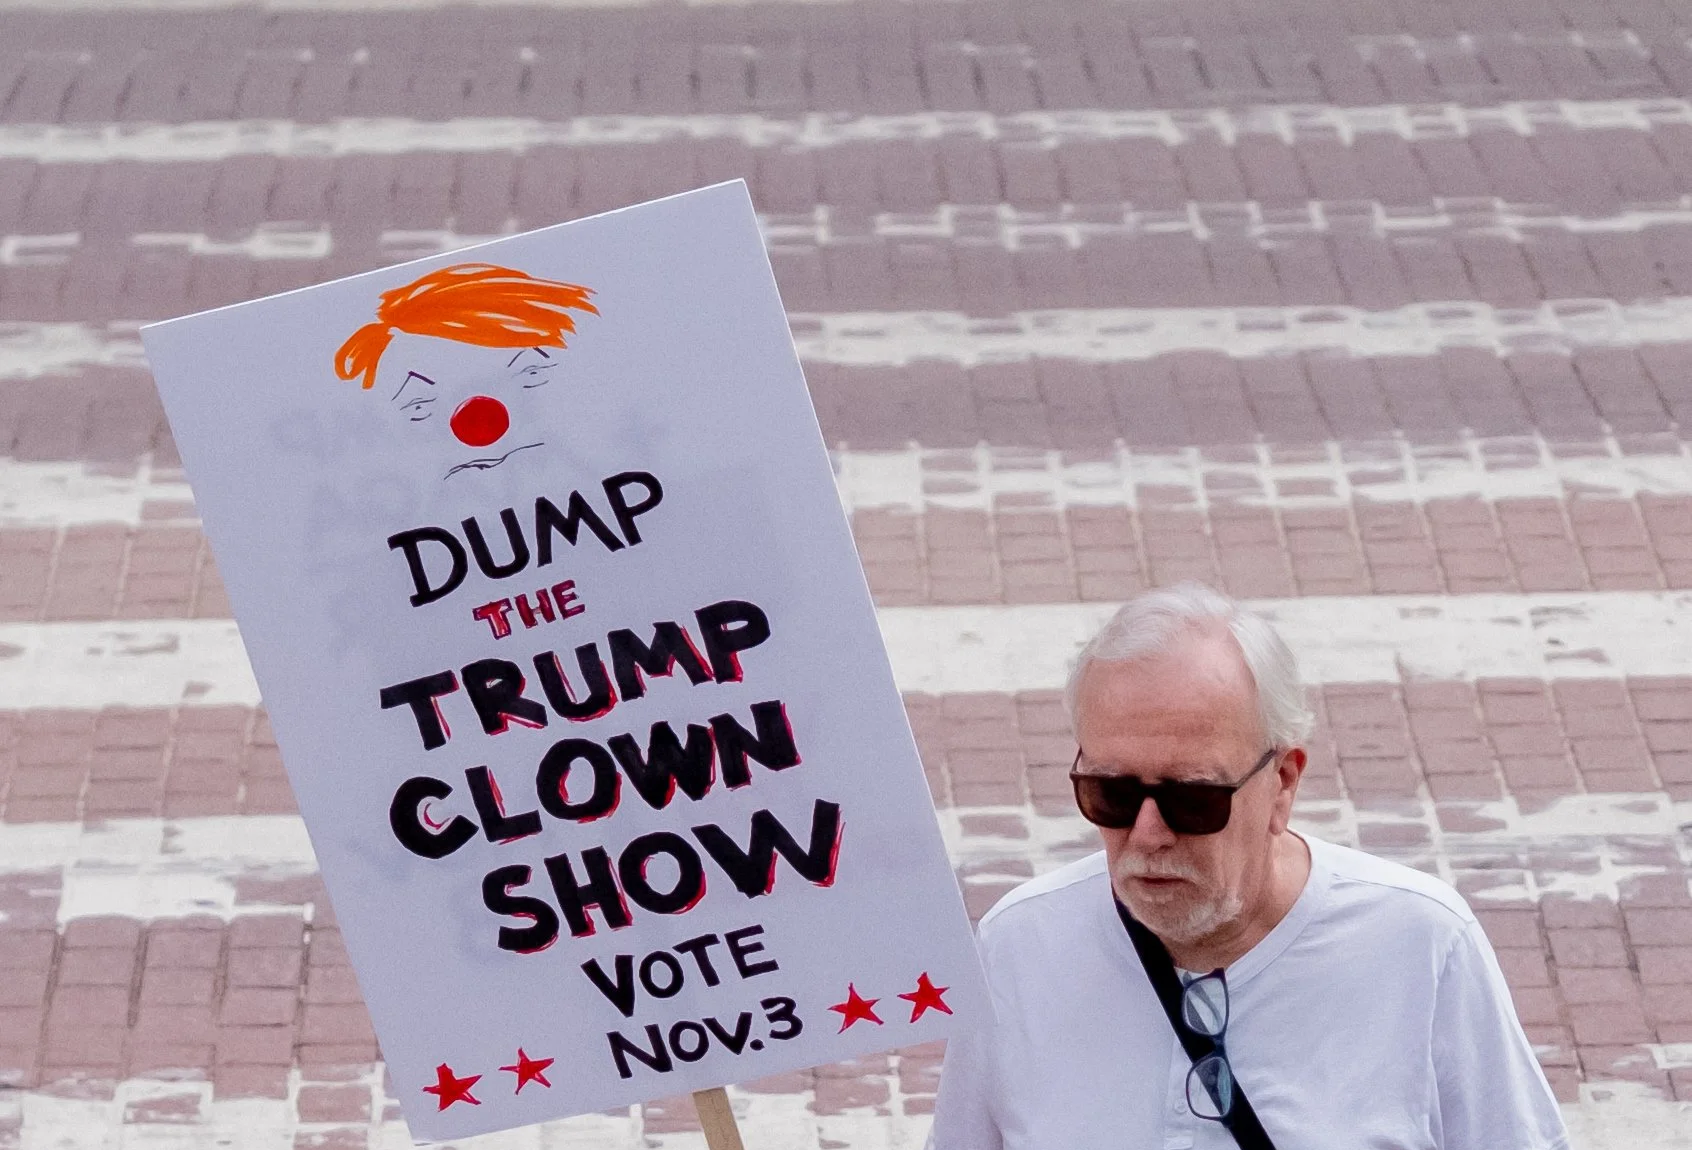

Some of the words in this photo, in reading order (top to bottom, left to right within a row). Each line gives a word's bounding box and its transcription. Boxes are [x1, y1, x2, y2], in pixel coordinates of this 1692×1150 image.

[387, 472, 664, 608] DUMP
[472, 580, 586, 640] THE
[380, 600, 772, 752] TRUMP
[389, 699, 803, 860] CLOWN
[481, 798, 847, 955] SHOW
[580, 923, 780, 1019] VOTE
